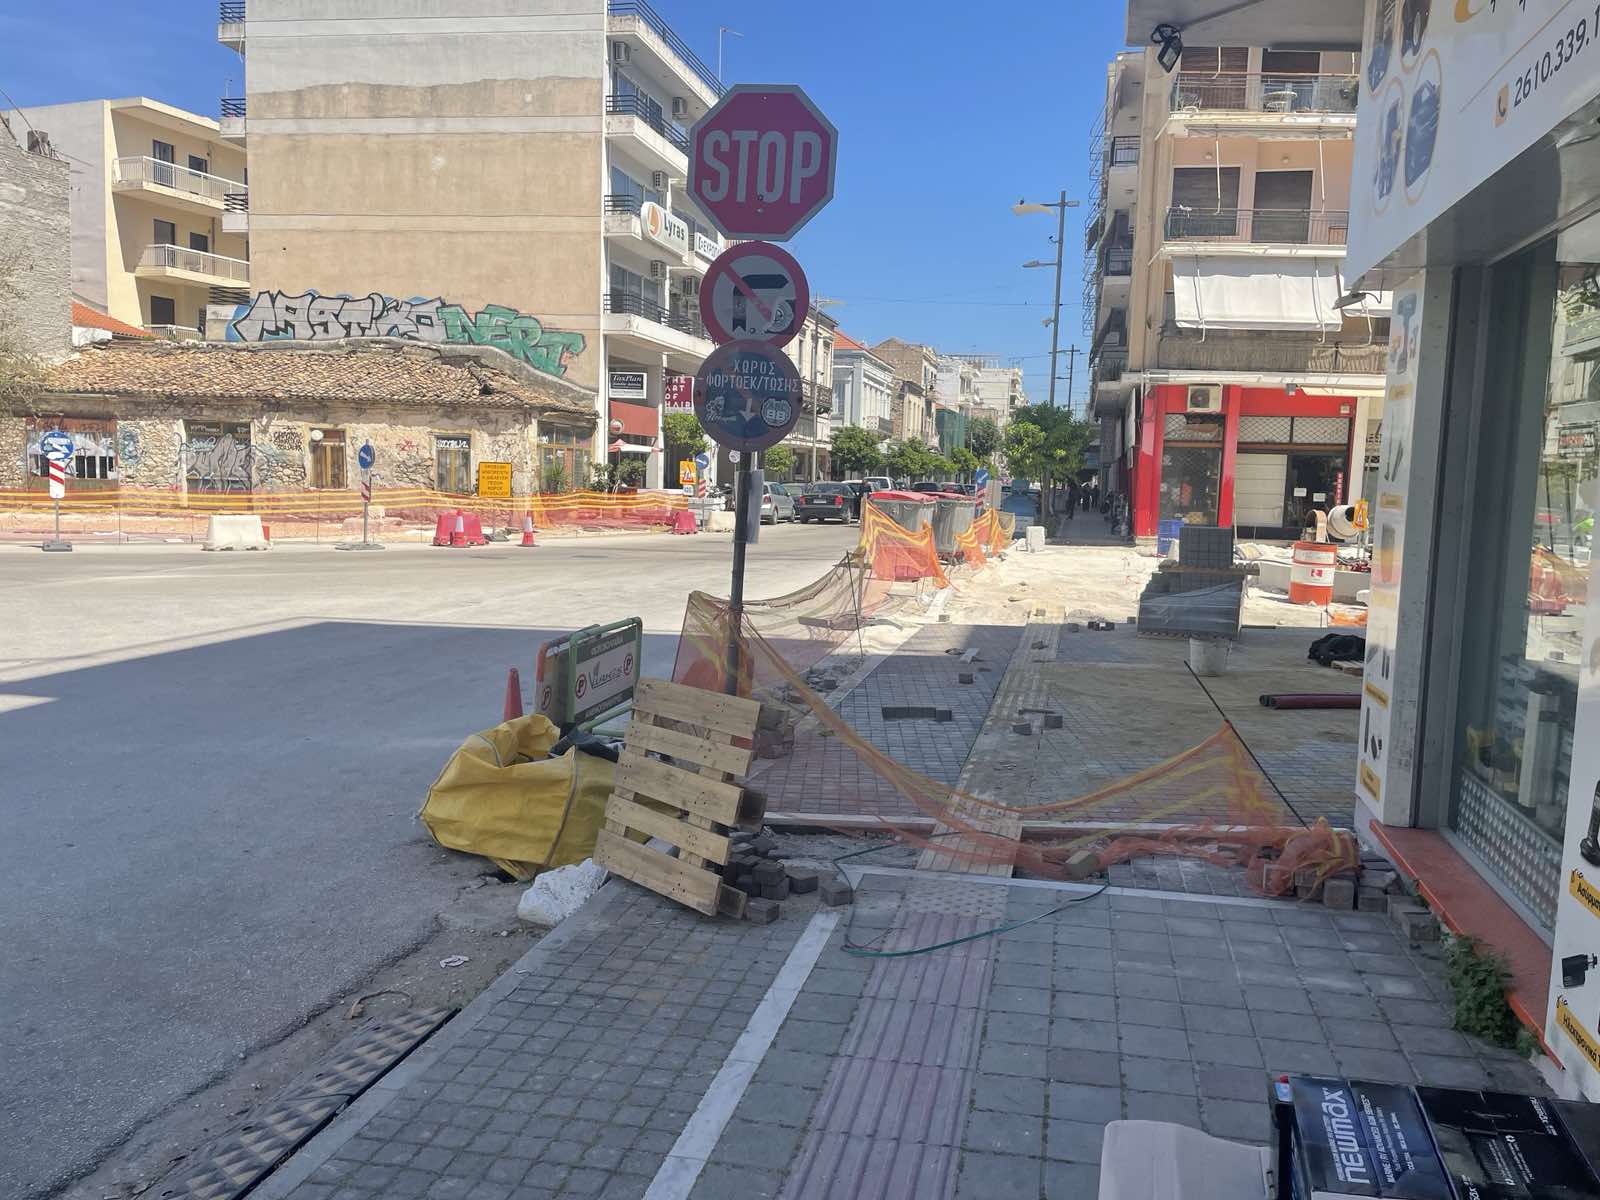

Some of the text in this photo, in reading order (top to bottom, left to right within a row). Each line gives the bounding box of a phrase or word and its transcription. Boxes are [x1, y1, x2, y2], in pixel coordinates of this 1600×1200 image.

[702, 130, 821, 204] STOP
[664, 213, 685, 240] Lyras
[734, 359, 776, 375] ΧΩΡΟΣ
[665, 376, 686, 384] THE
[665, 384, 685, 392] ART
[1321, 1087, 1371, 1184] newmax
